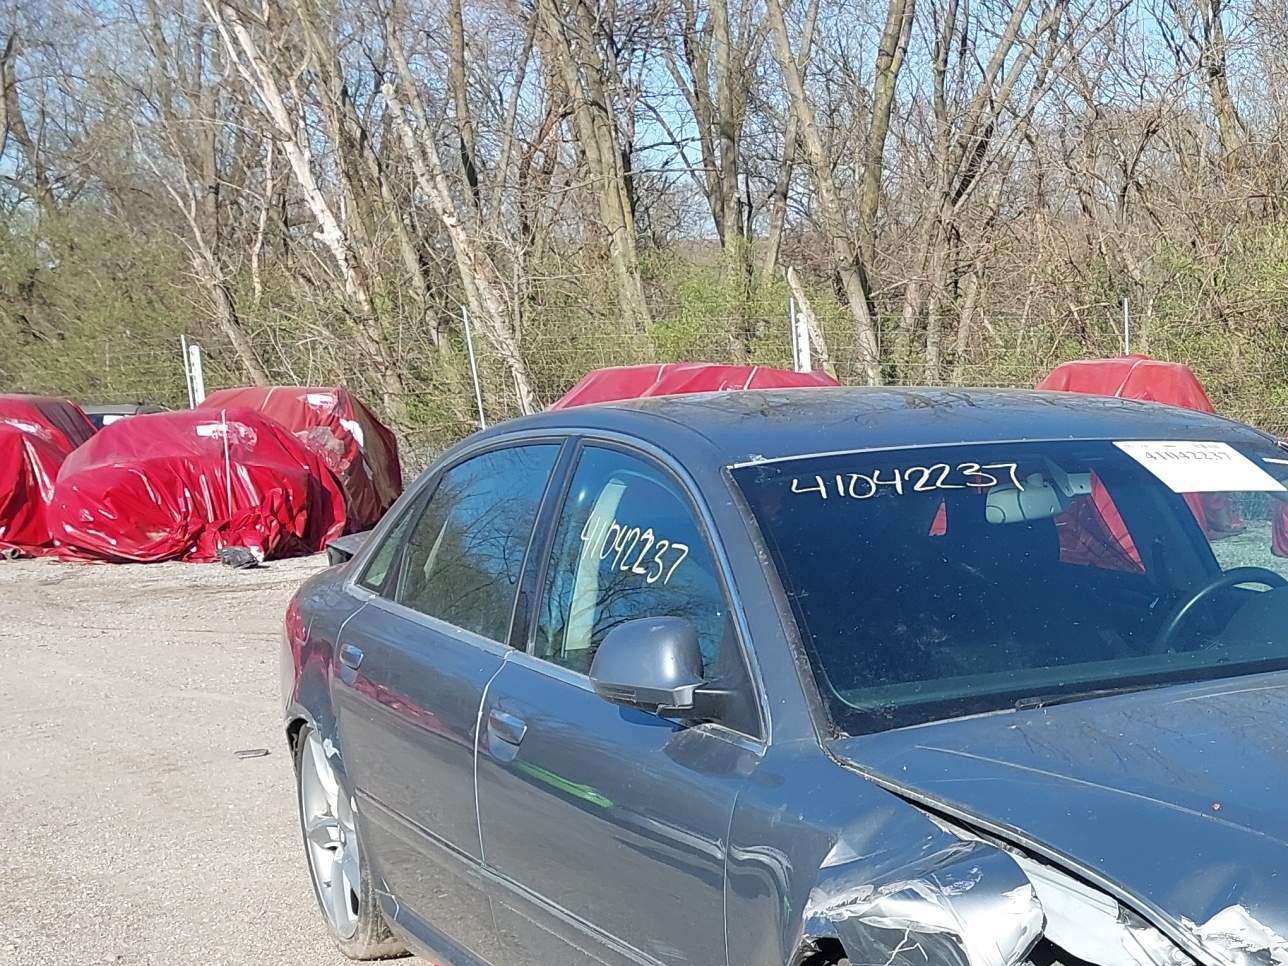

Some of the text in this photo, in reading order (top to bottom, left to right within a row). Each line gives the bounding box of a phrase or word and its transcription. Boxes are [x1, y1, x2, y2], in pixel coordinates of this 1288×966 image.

[1144, 450, 1232, 461] 41042237
[790, 462, 1026, 500] 41042237
[580, 513, 689, 586] 41042237
